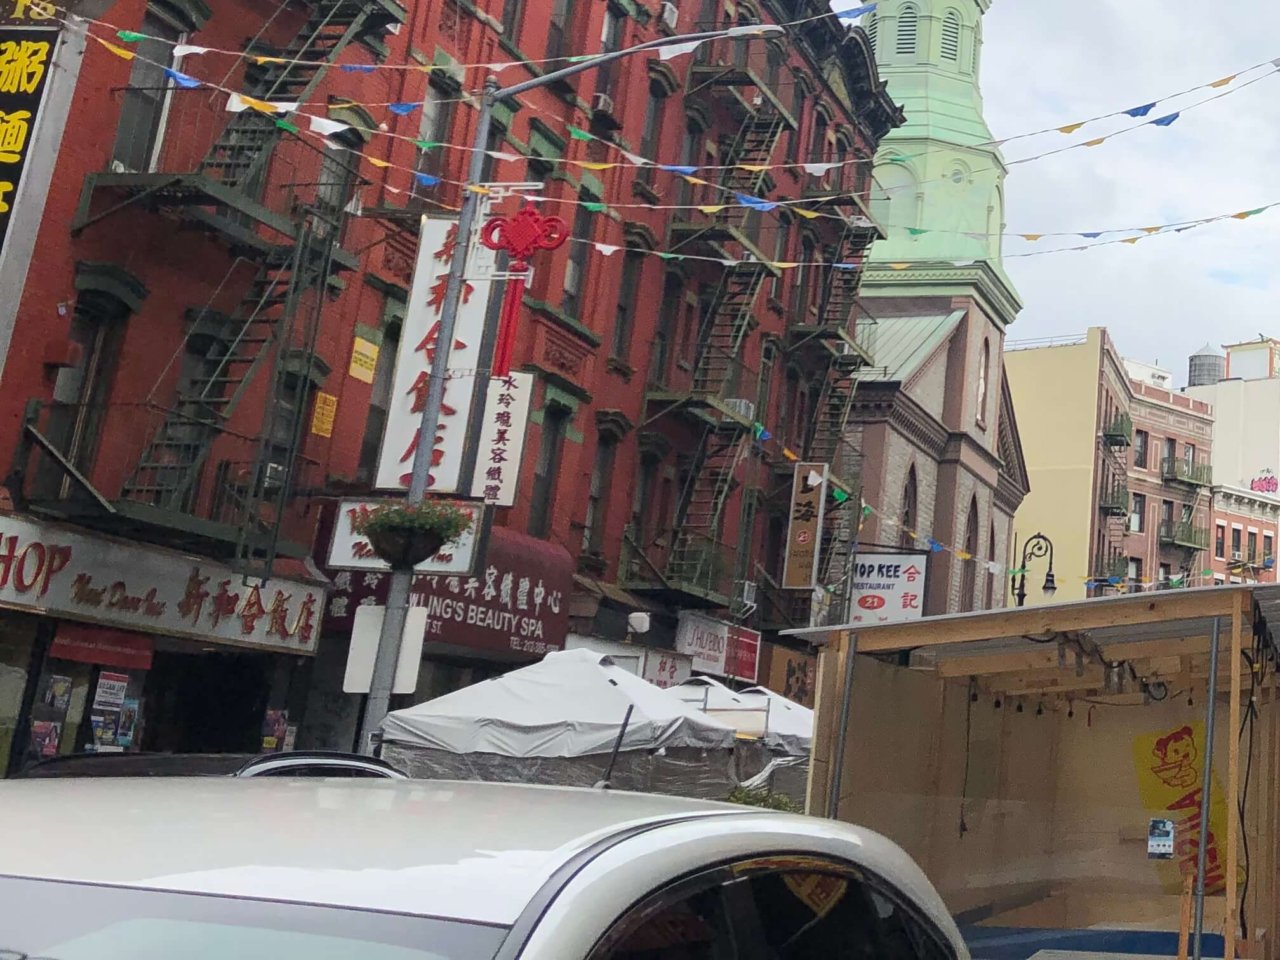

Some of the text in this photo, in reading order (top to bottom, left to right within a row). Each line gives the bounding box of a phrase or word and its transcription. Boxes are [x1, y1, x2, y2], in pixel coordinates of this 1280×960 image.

[877, 563, 900, 578] KEE
[901, 564, 921, 609] 合記
[467, 604, 519, 634] BEAUTY
[520, 617, 544, 639] SPA
